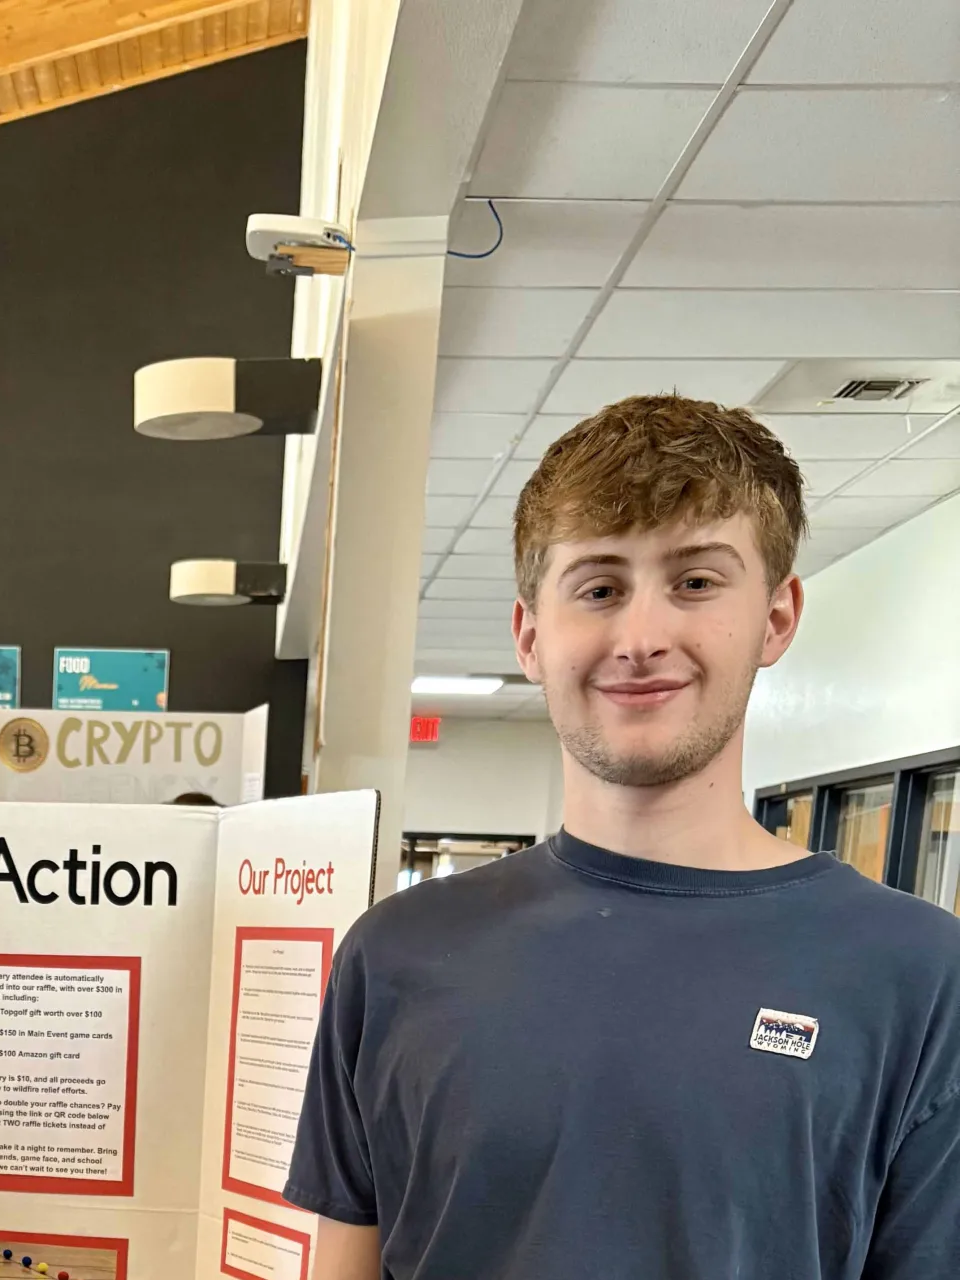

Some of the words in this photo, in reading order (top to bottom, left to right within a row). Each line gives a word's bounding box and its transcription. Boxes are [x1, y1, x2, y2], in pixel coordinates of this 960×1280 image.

[56, 716, 223, 768] CRYPTO
[238, 858, 269, 894] Our
[273, 857, 334, 904] Project
[45, 973, 52, 981] is
[53, 974, 104, 984] automatically
[5, 983, 21, 991] into
[59, 984, 75, 992] with
[95, 985, 114, 993] $300
[0, 1007, 28, 1017] Topgolf
[28, 1008, 42, 1017] gift
[84, 1010, 102, 1018] $100
[0, 1028, 17, 1036] $150
[27, 1029, 45, 1037] Main
[46, 1030, 68, 1038] Event
[69, 1032, 90, 1040] game
[754, 1033, 789, 1046] JACKSON
[791, 1040, 811, 1051] HOLE
[757, 1040, 806, 1054] WYOMING
[17, 1050, 48, 1058] Amazon
[49, 1051, 62, 1060] gift
[8, 1074, 15, 1082] is
[59, 1077, 94, 1085] proceeds
[12, 1085, 40, 1093] wildfire
[40, 1086, 60, 1094] relief
